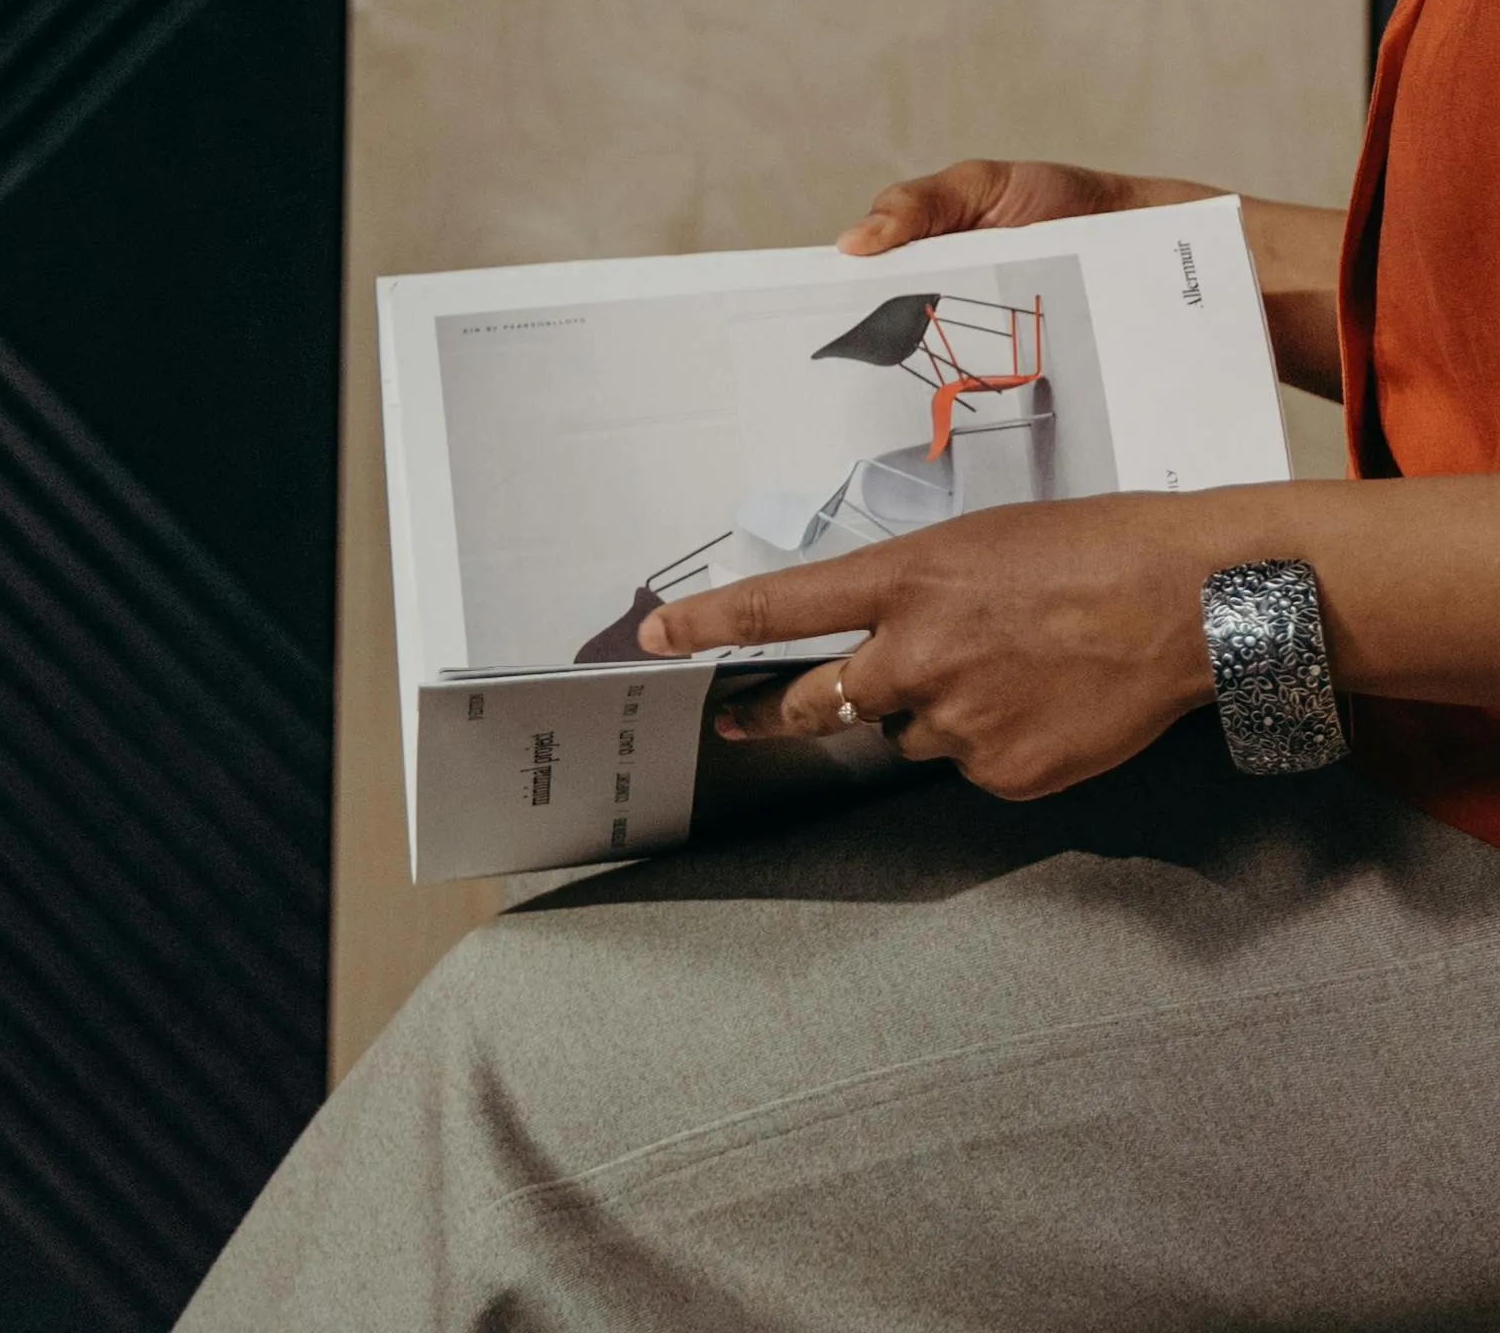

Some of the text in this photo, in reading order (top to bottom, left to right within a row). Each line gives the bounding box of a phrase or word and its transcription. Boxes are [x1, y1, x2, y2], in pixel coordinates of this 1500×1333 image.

[1173, 240, 1204, 309] Allermuir
[1166, 469, 1180, 489] ILY
[618, 729, 635, 756] QUALITY
[520, 731, 560, 806] minimal project
[614, 772, 631, 804] COMFORT
